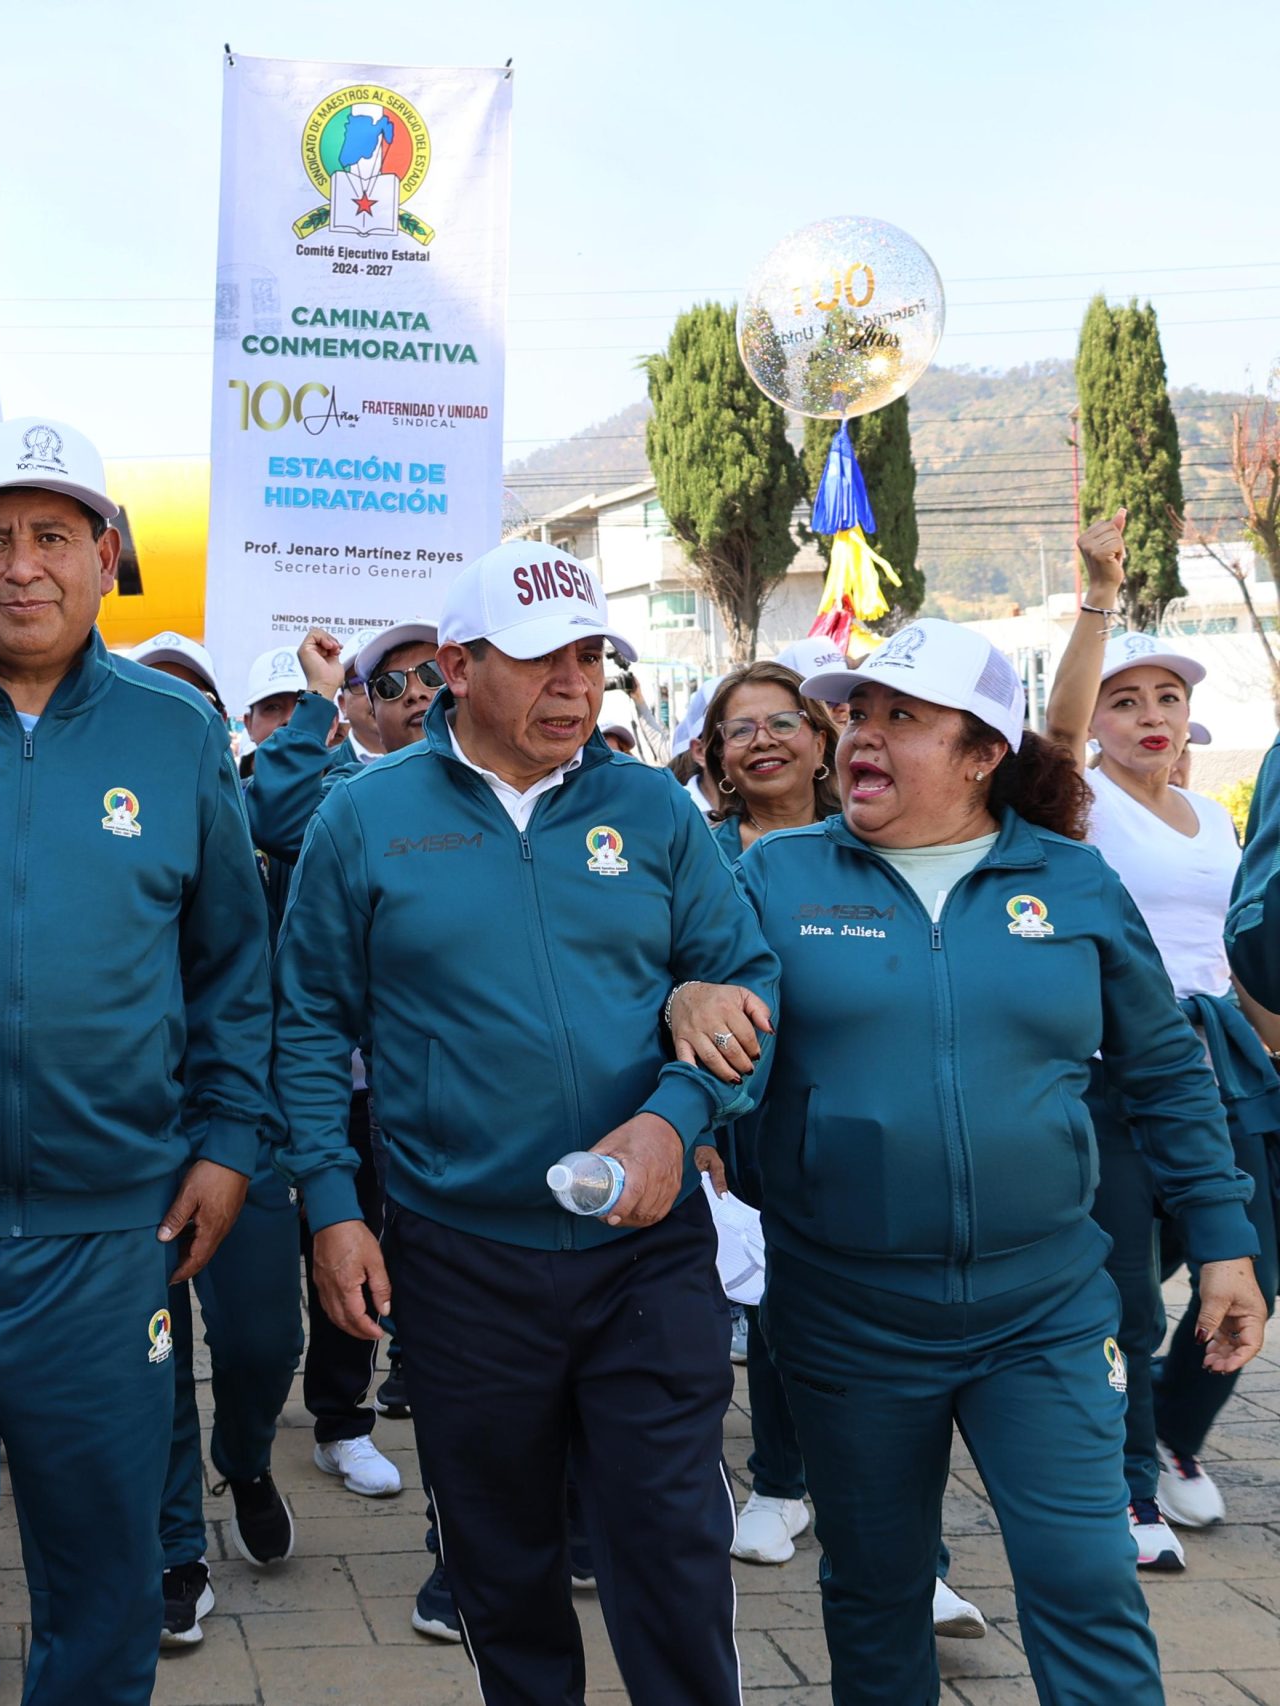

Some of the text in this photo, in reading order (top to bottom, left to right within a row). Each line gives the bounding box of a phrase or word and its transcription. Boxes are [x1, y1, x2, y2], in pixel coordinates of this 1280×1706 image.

[306, 89, 426, 193] SINDICATO DE MAESTROS AL SERVICIO DEL ESTADO
[296, 244, 430, 262] Comité Ejecutivo Estatal
[332, 262, 358, 275] 2024
[366, 264, 392, 276] 2027
[291, 306, 431, 332] CAMINATA
[241, 334, 479, 364] CONMEMORATIVA
[362, 400, 489, 420] FRATERNIDAD Y UNIDAD
[392, 417, 457, 429] SINDICAL
[268, 455, 446, 485] ESTACIÓN DE
[264, 486, 449, 515] HIDRATACIÓN
[244, 541, 464, 566] Prof. Jenaro Martínez Reyes
[274, 560, 433, 580] Secretario General
[513, 560, 598, 609] SMSEM
[272, 614, 399, 627] UNIDOS POR EL BIENESTA
[272, 623, 291, 632] DEL
[384, 831, 483, 858] SMSEM
[792, 903, 897, 921] SMSEM
[799, 925, 886, 939] Mtra. Julieta
